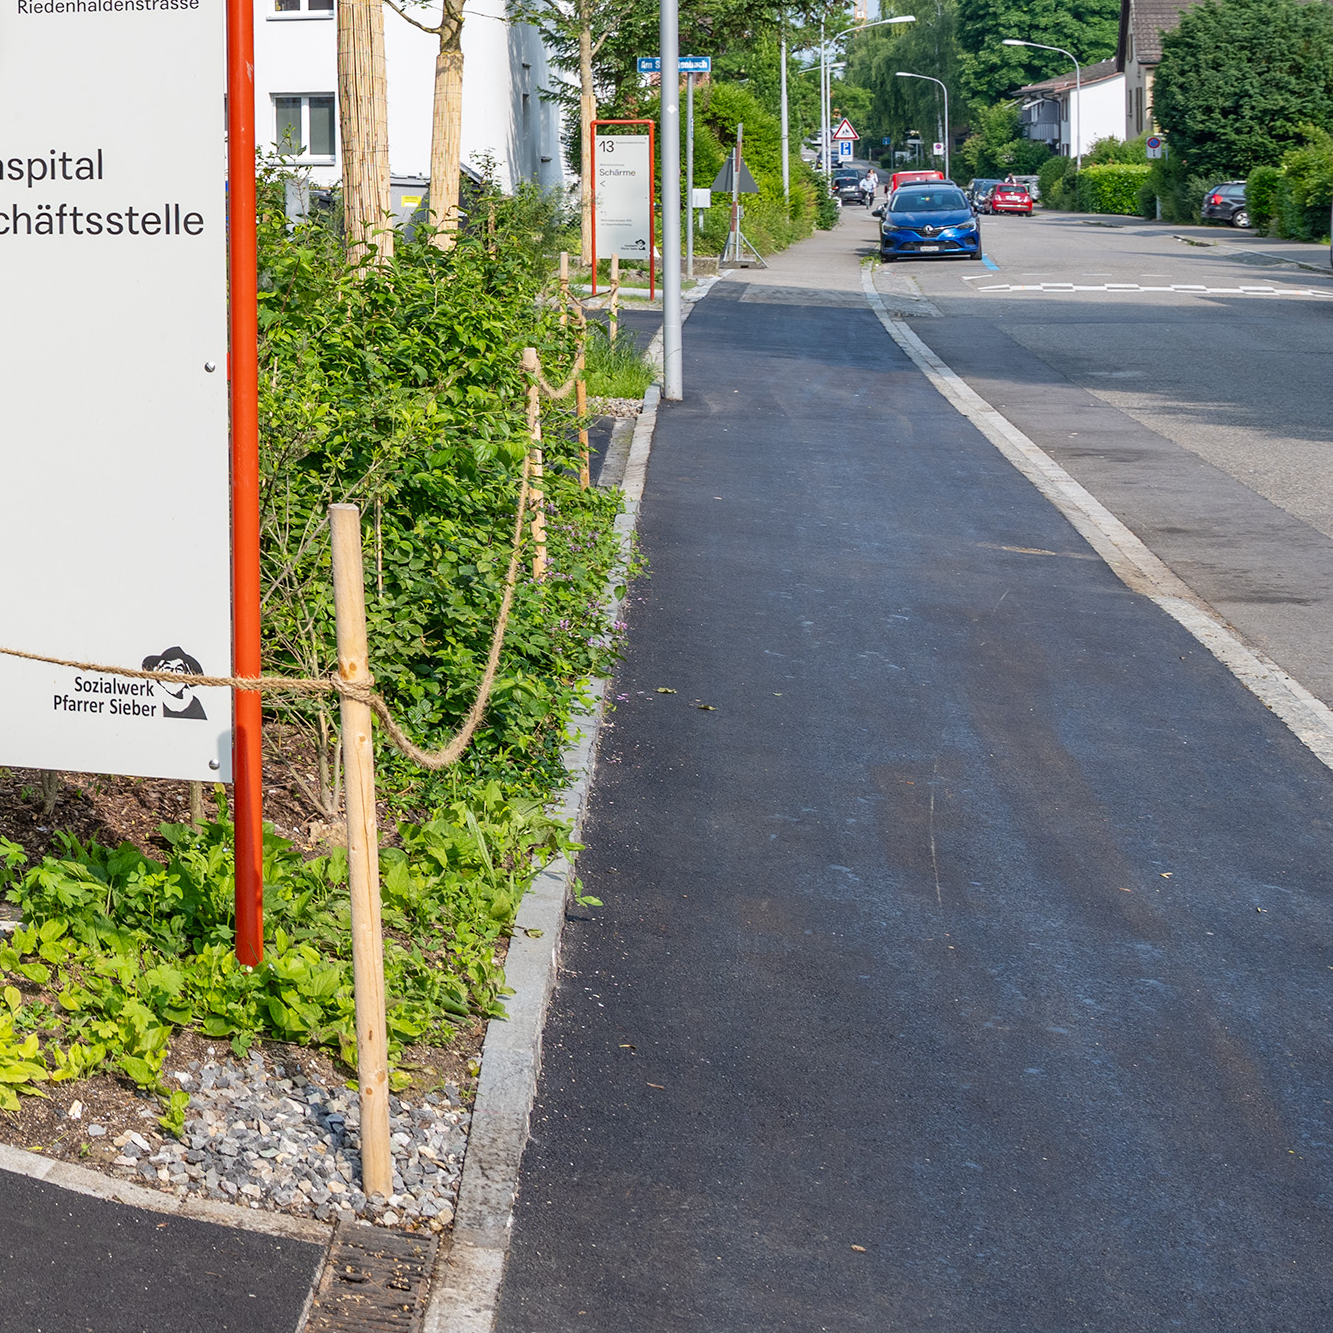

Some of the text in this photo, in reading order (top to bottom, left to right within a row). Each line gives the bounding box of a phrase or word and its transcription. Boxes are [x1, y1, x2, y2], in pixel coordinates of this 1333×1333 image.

[641, 60, 653, 69] Am
[599, 140, 615, 153] 13
[599, 168, 636, 177] Schärme
[74, 676, 154, 697] Sozialwerk
[53, 695, 157, 717] Pfarrer Sieber
